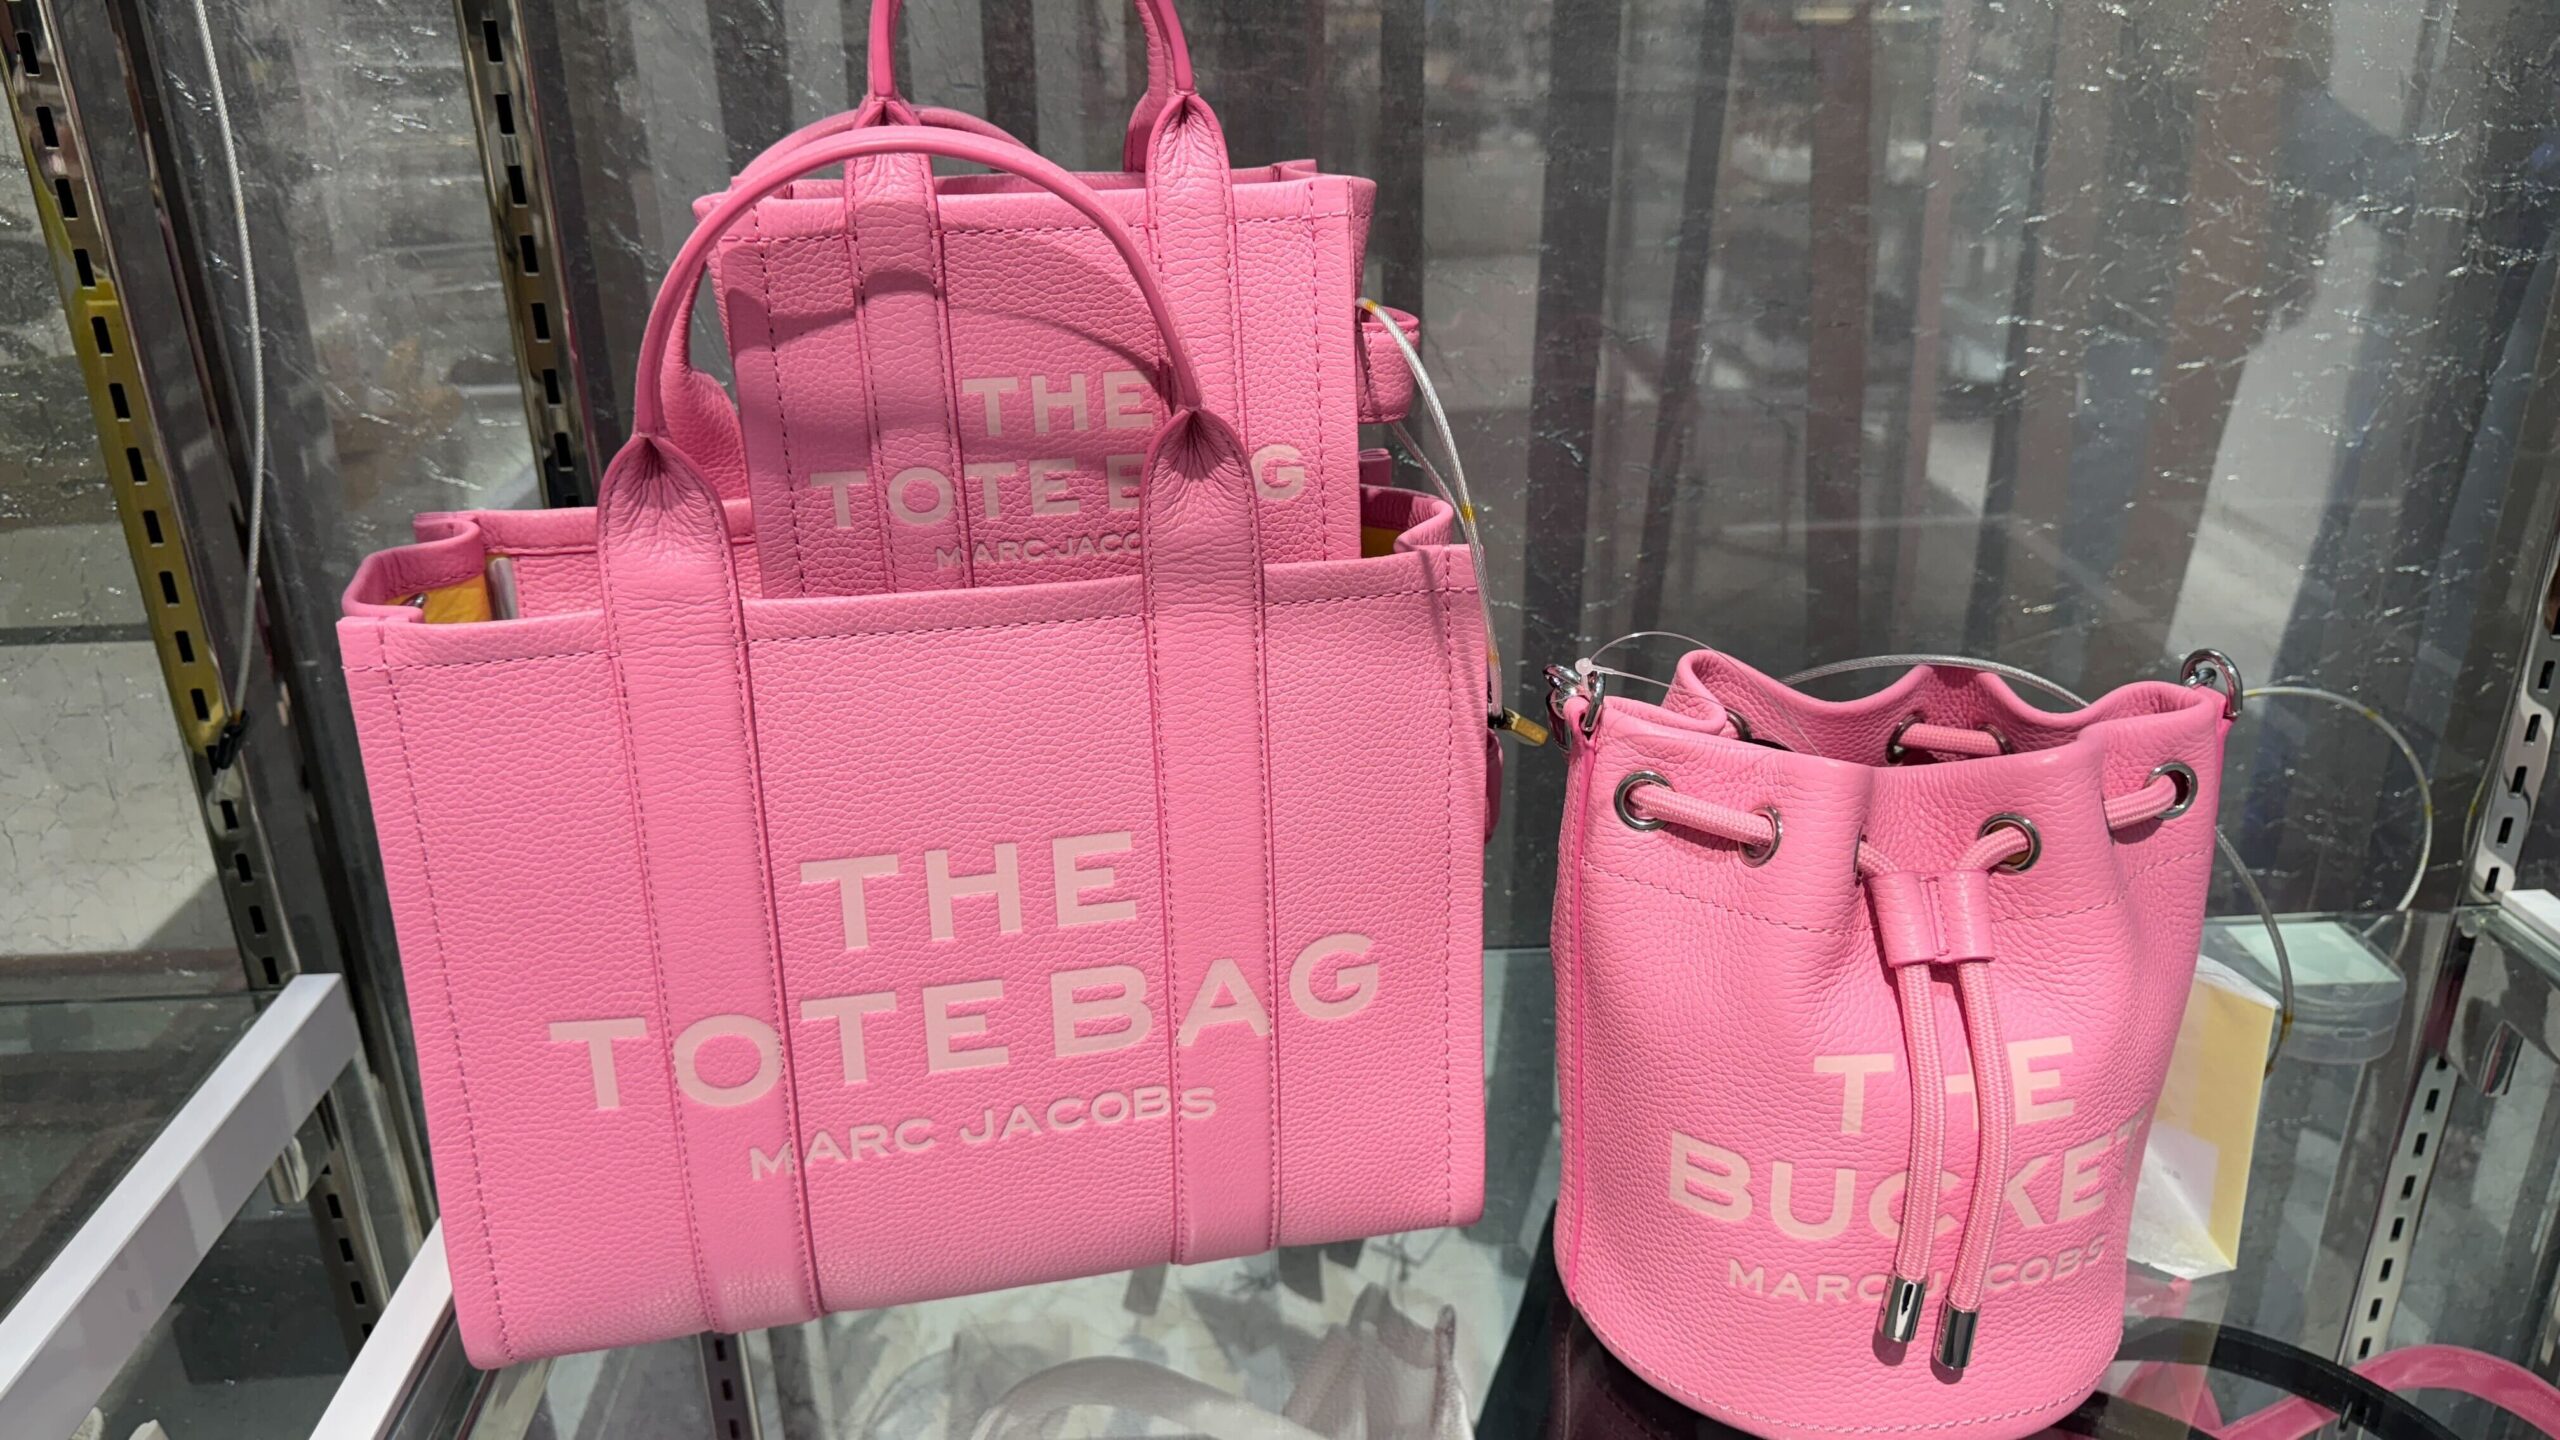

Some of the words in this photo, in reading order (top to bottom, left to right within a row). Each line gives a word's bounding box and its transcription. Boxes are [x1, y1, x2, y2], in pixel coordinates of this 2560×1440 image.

[962, 369, 1153, 437] THE
[809, 457, 1080, 530] TOTE
[1106, 443, 1305, 514] BG
[936, 538, 1046, 569] MARC
[1053, 530, 1142, 558] JACO
[801, 830, 1137, 952] THE
[549, 977, 1009, 1110] TOTE
[1050, 932, 1381, 1059] BAG
[749, 1117, 936, 1181] MARC
[959, 1085, 1219, 1144] JACOBS
[1728, 1256, 1890, 1303] MARC
[1925, 1236, 2107, 1298] JCOBS
